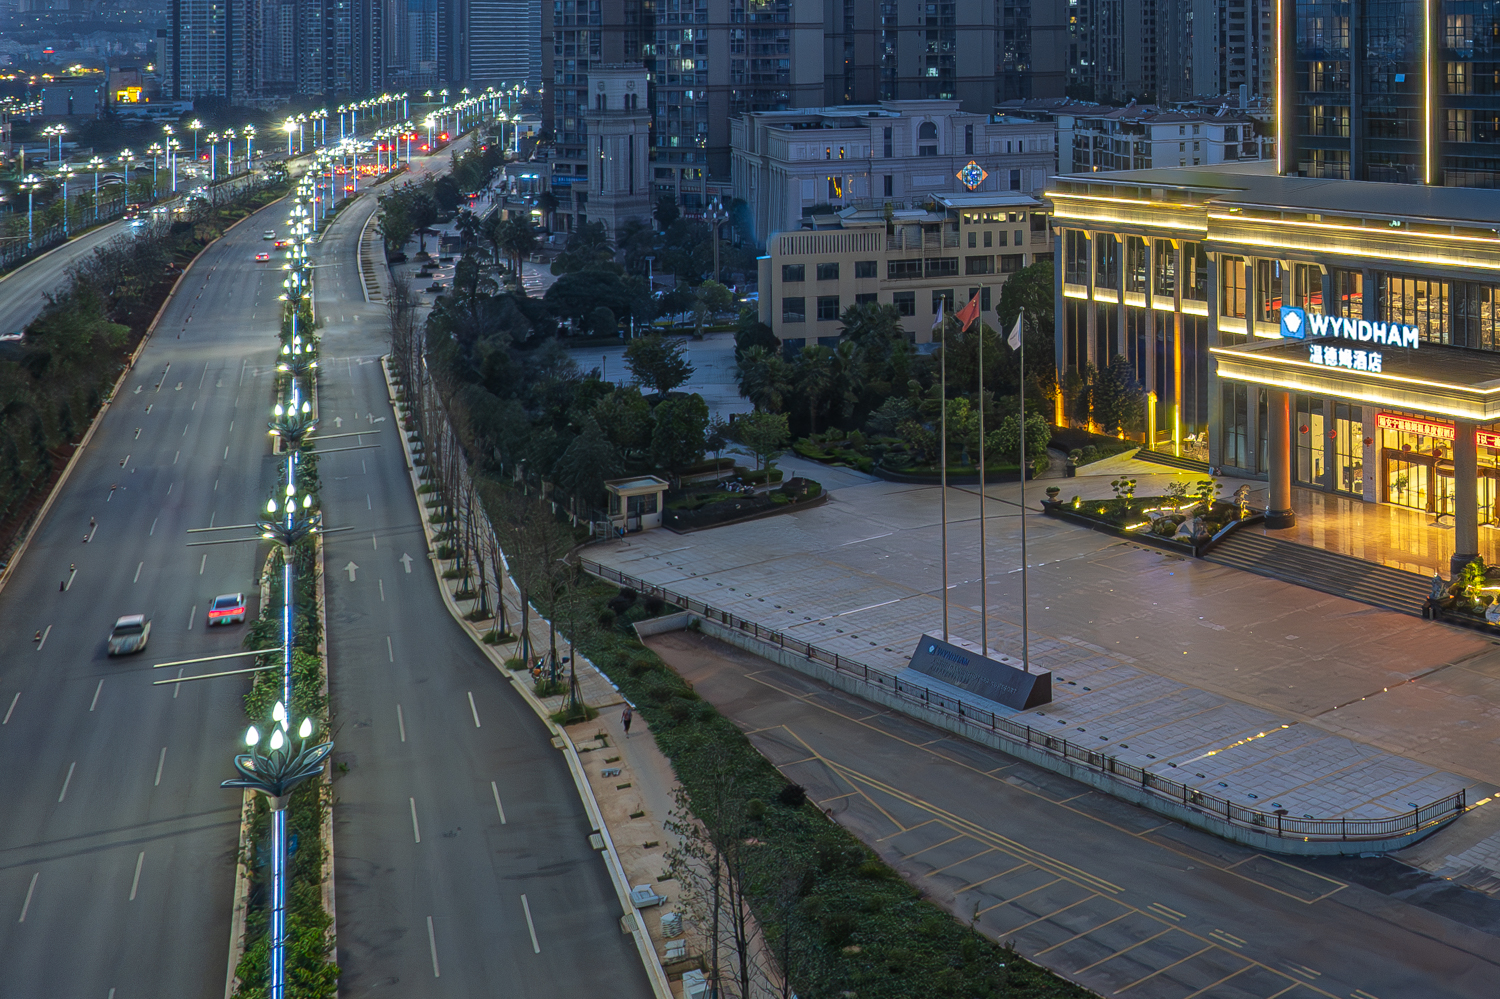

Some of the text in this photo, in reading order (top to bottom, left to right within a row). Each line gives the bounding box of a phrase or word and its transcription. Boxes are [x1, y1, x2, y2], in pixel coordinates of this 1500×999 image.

[1308, 313, 1419, 349] WYNDHAM
[1309, 344, 1382, 373] 温德姆酒店
